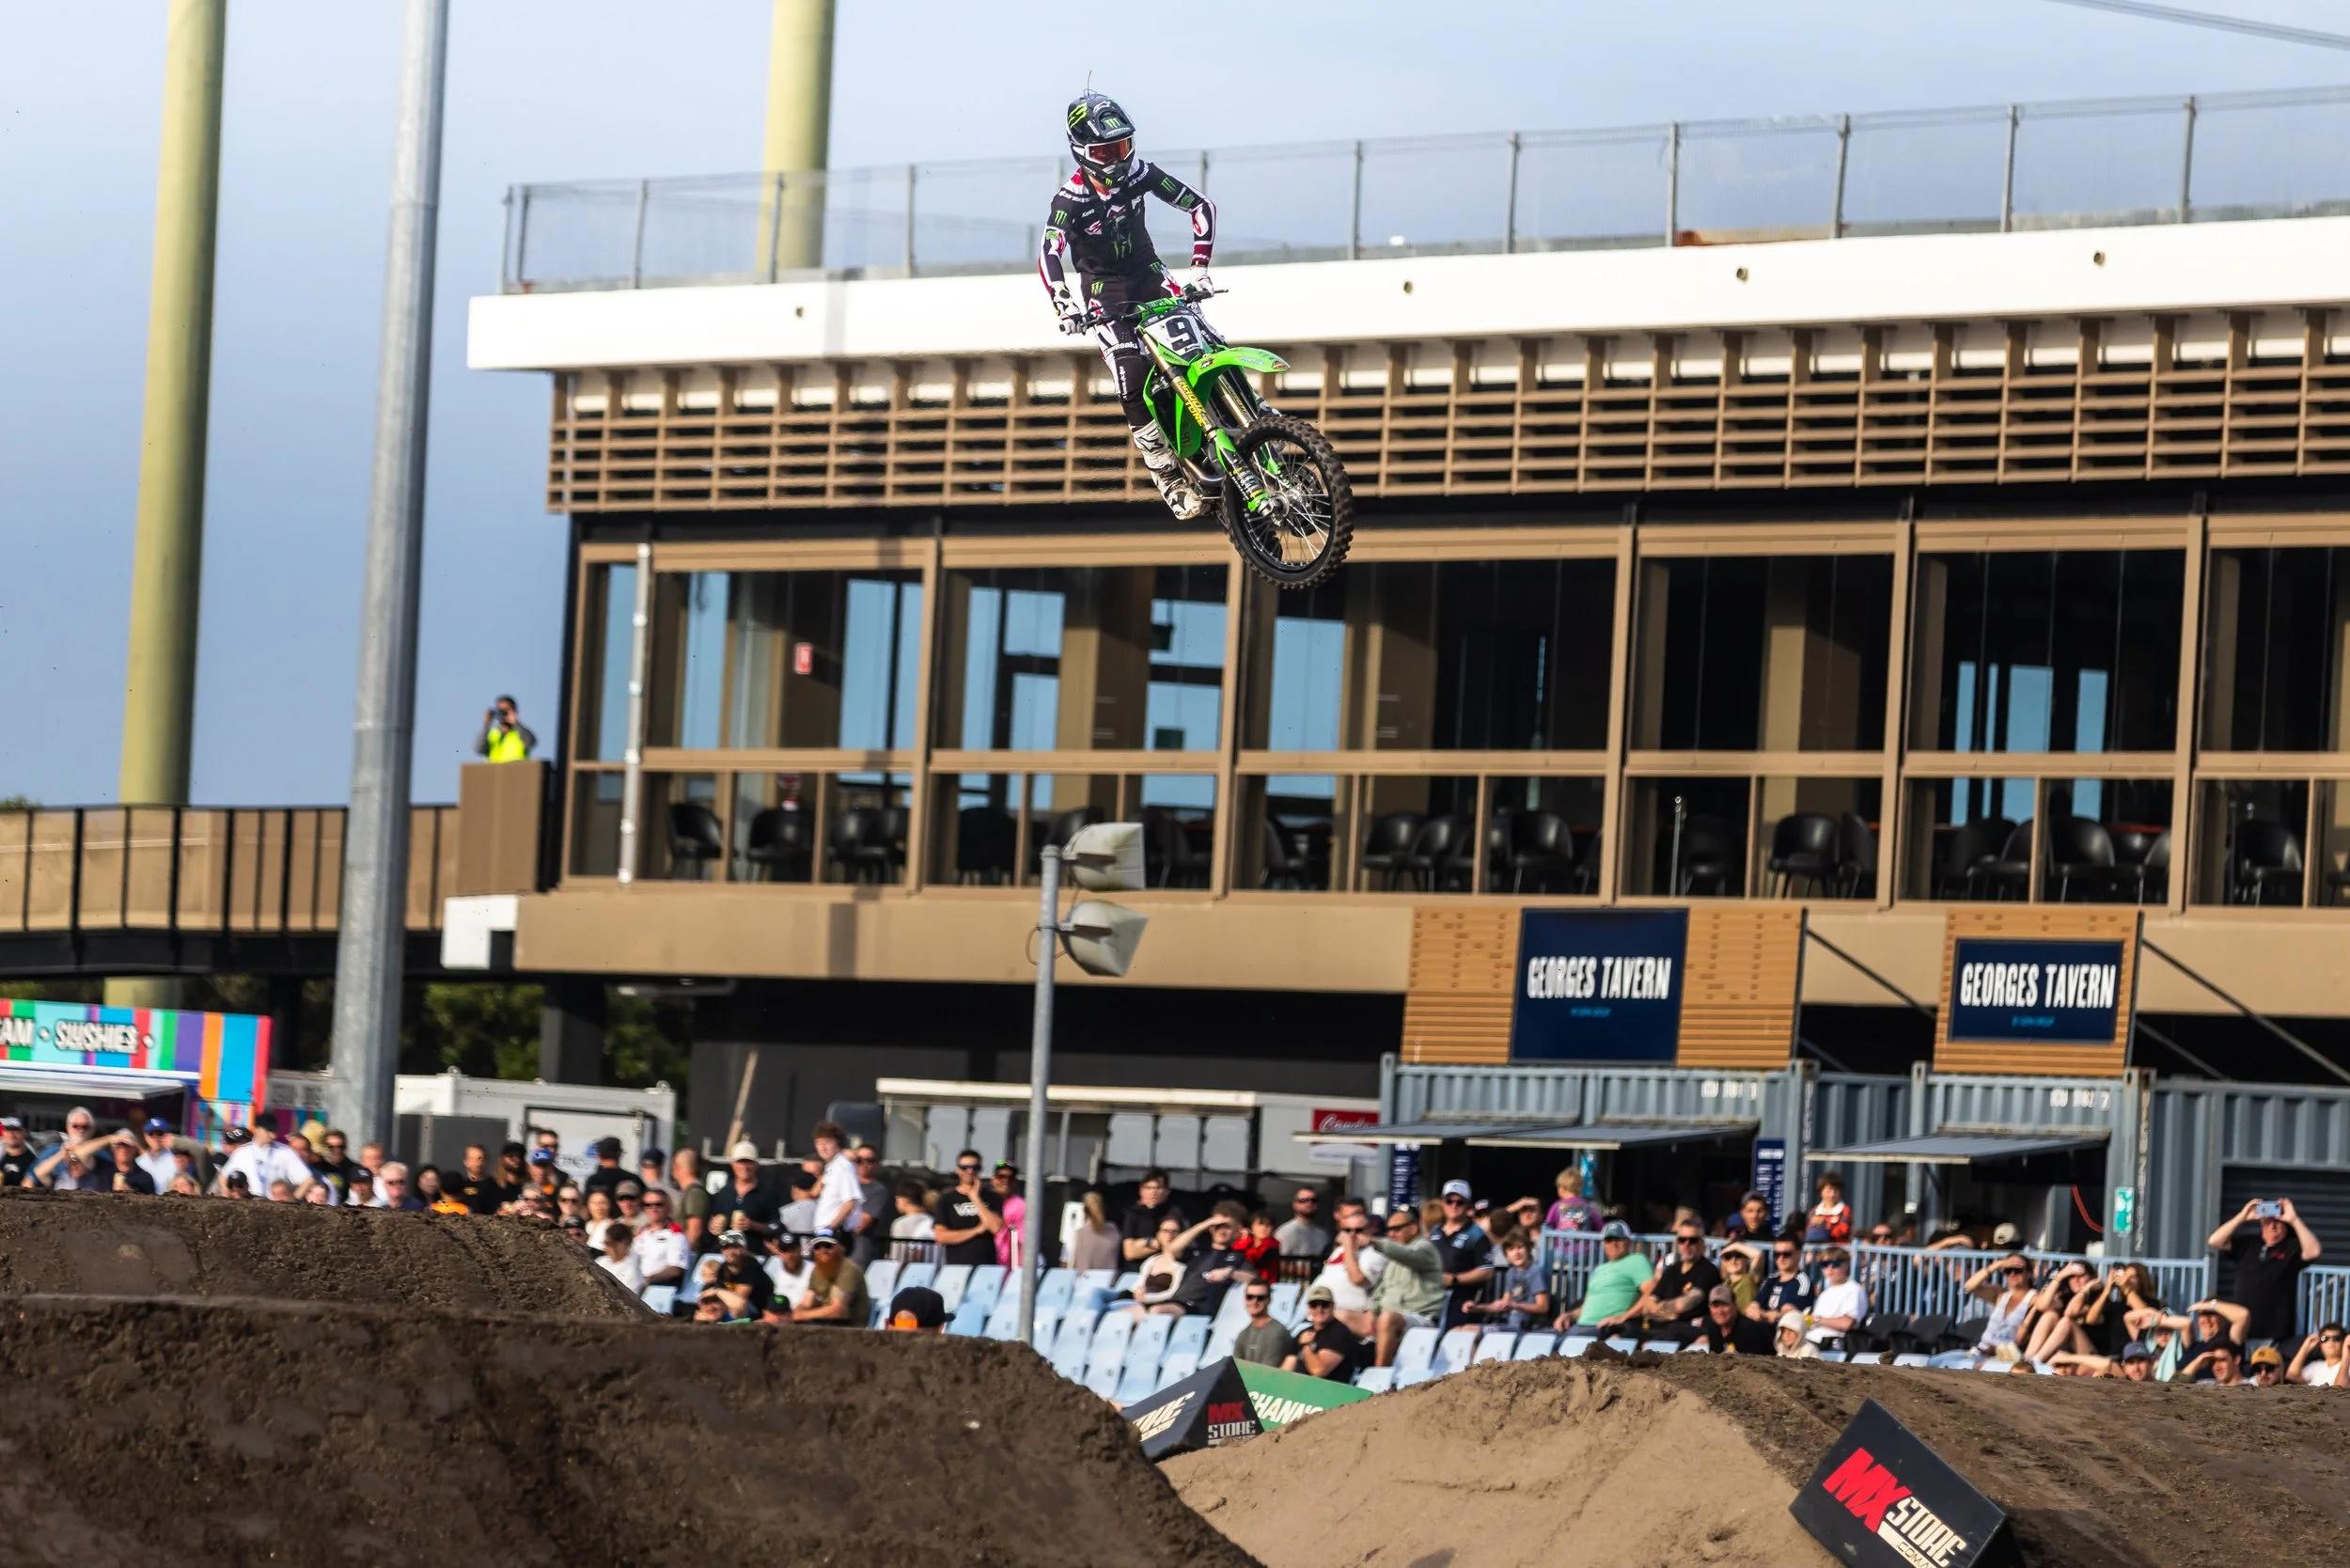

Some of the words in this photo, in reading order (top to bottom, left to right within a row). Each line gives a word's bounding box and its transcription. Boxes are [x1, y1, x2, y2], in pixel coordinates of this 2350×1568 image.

[1166, 315, 1198, 353] 9
[1184, 399, 1206, 427] TUNE
[1527, 955, 1598, 1000] GEORGES
[1599, 955, 1673, 1001] TAVERN
[1959, 961, 2040, 1009] GEORGES
[2044, 963, 2117, 1010] TAVERN
[54, 1018, 140, 1056] SLUSHIES
[1207, 1401, 1246, 1426] MX
[1207, 1419, 1256, 1439] STORE
[1822, 1447, 1913, 1534] MX
[1885, 1496, 1967, 1568] STORE
